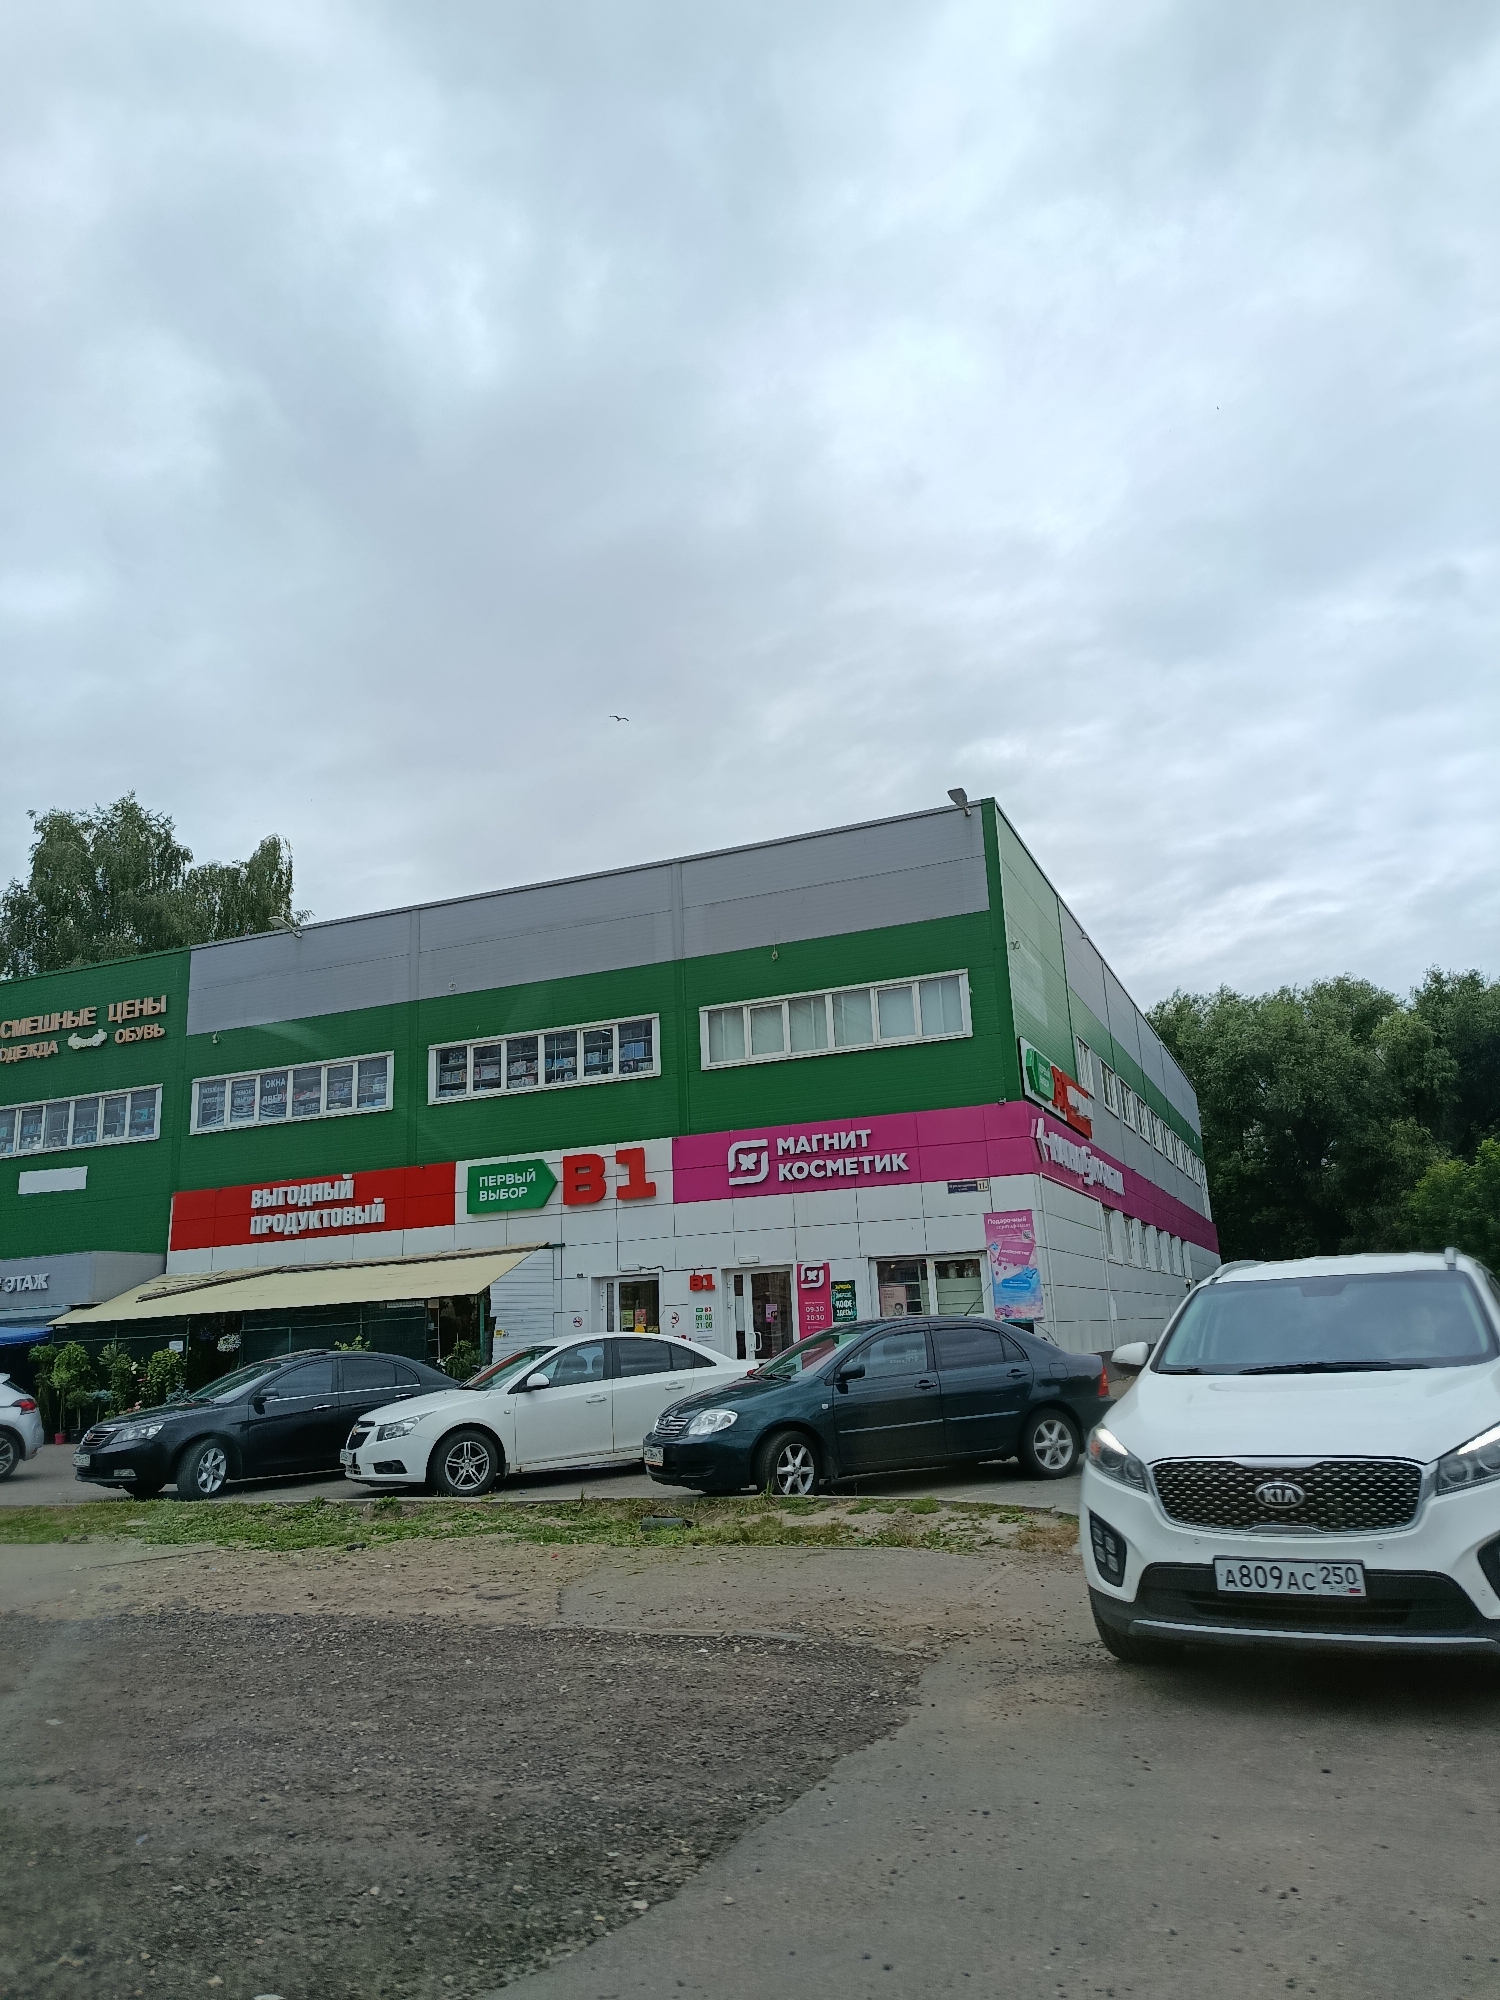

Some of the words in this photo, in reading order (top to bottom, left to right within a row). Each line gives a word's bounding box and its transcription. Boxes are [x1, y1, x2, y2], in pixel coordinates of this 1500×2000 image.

[0, 1006, 98, 1039] СМЕШНЫЕ
[107, 995, 167, 1023] ЦЕНЫ
[0, 1040, 58, 1063] ОДЕЖДА
[114, 1023, 166, 1044] ОБУВЬ
[265, 1077, 286, 1089] ОКНА
[777, 1129, 872, 1156] МАГНИТ
[778, 1153, 909, 1181] КОСМЕТИК
[479, 1168, 536, 1188] ПЕРВЫЙ
[251, 1173, 354, 1208] ВЫГОДНЫЙ
[479, 1187, 528, 1202] ВЫБОР
[250, 1198, 385, 1235] ПРОДУКТОВЫЙ
[987, 1216, 1027, 1225] Подарочный
[4, 1273, 50, 1292] ЭТАЖ
[1262, 1488, 1297, 1503] KIA
[1319, 1566, 1357, 1585] 250
